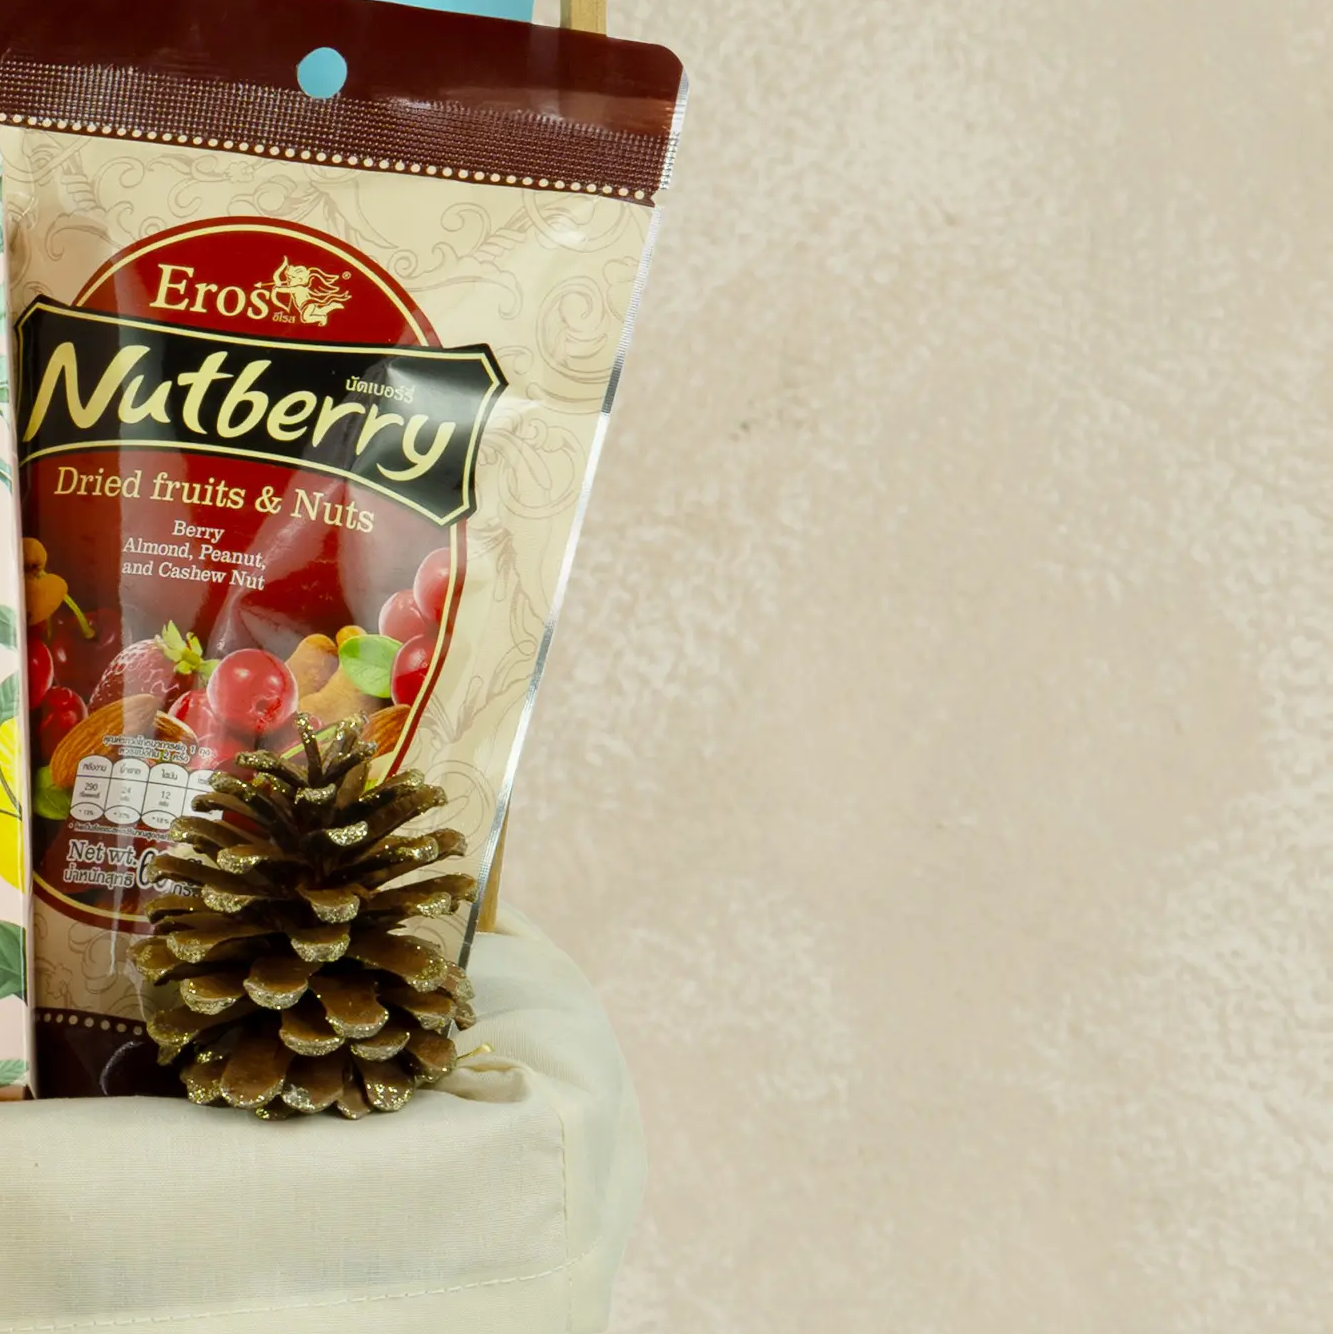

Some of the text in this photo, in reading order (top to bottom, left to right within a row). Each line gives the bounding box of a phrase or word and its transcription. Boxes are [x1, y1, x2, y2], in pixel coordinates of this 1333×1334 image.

[149, 263, 271, 322] Eros
[22, 342, 457, 481] Nutberry
[54, 466, 376, 534] Dried fruits & Nuts
[172, 520, 225, 544] Berry
[123, 536, 267, 570] Almond, Peanut,
[122, 560, 266, 591] and Cashew Nut
[163, 751, 169, 760] 2
[68, 840, 104, 862] Net
